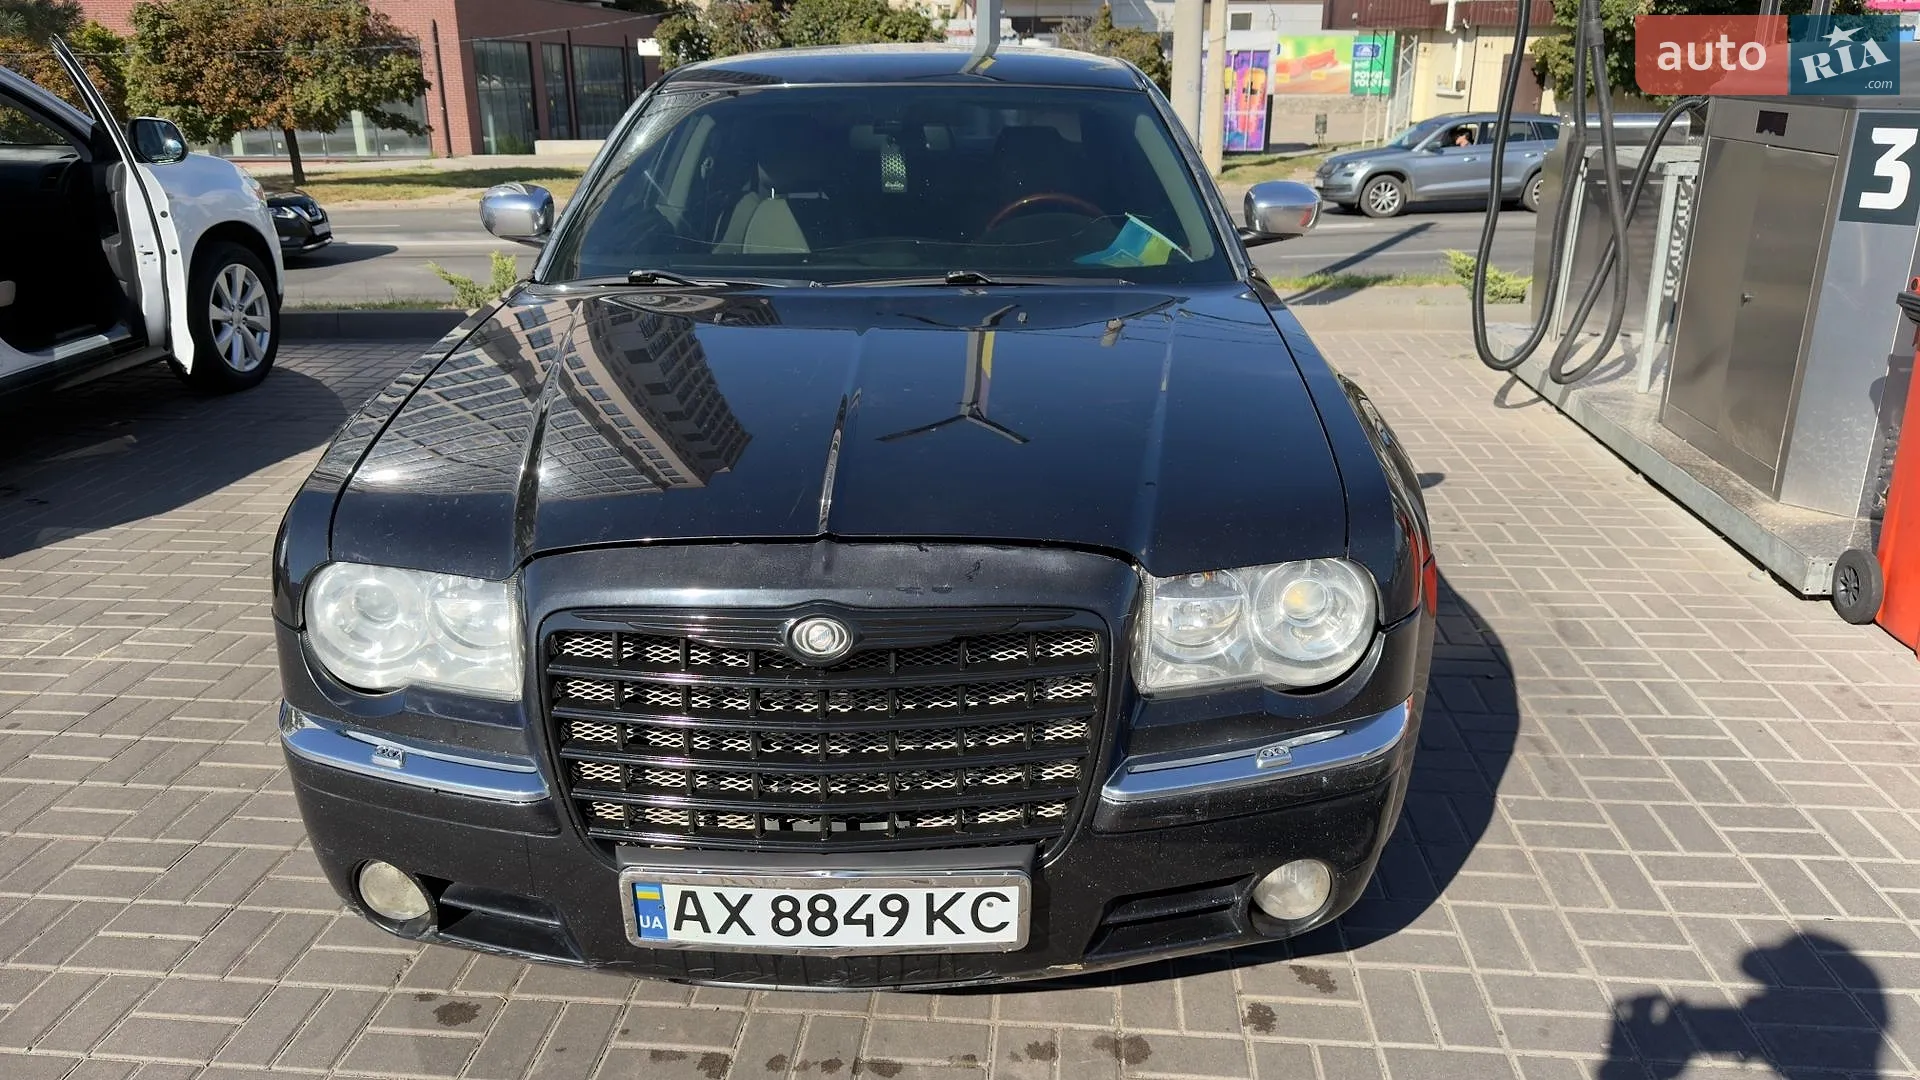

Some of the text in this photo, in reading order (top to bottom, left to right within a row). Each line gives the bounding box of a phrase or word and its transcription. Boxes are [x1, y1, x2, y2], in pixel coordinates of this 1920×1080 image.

[1858, 127, 1919, 210] 3
[639, 914, 664, 930] UA
[673, 890, 1010, 938] AX 8849 KC
